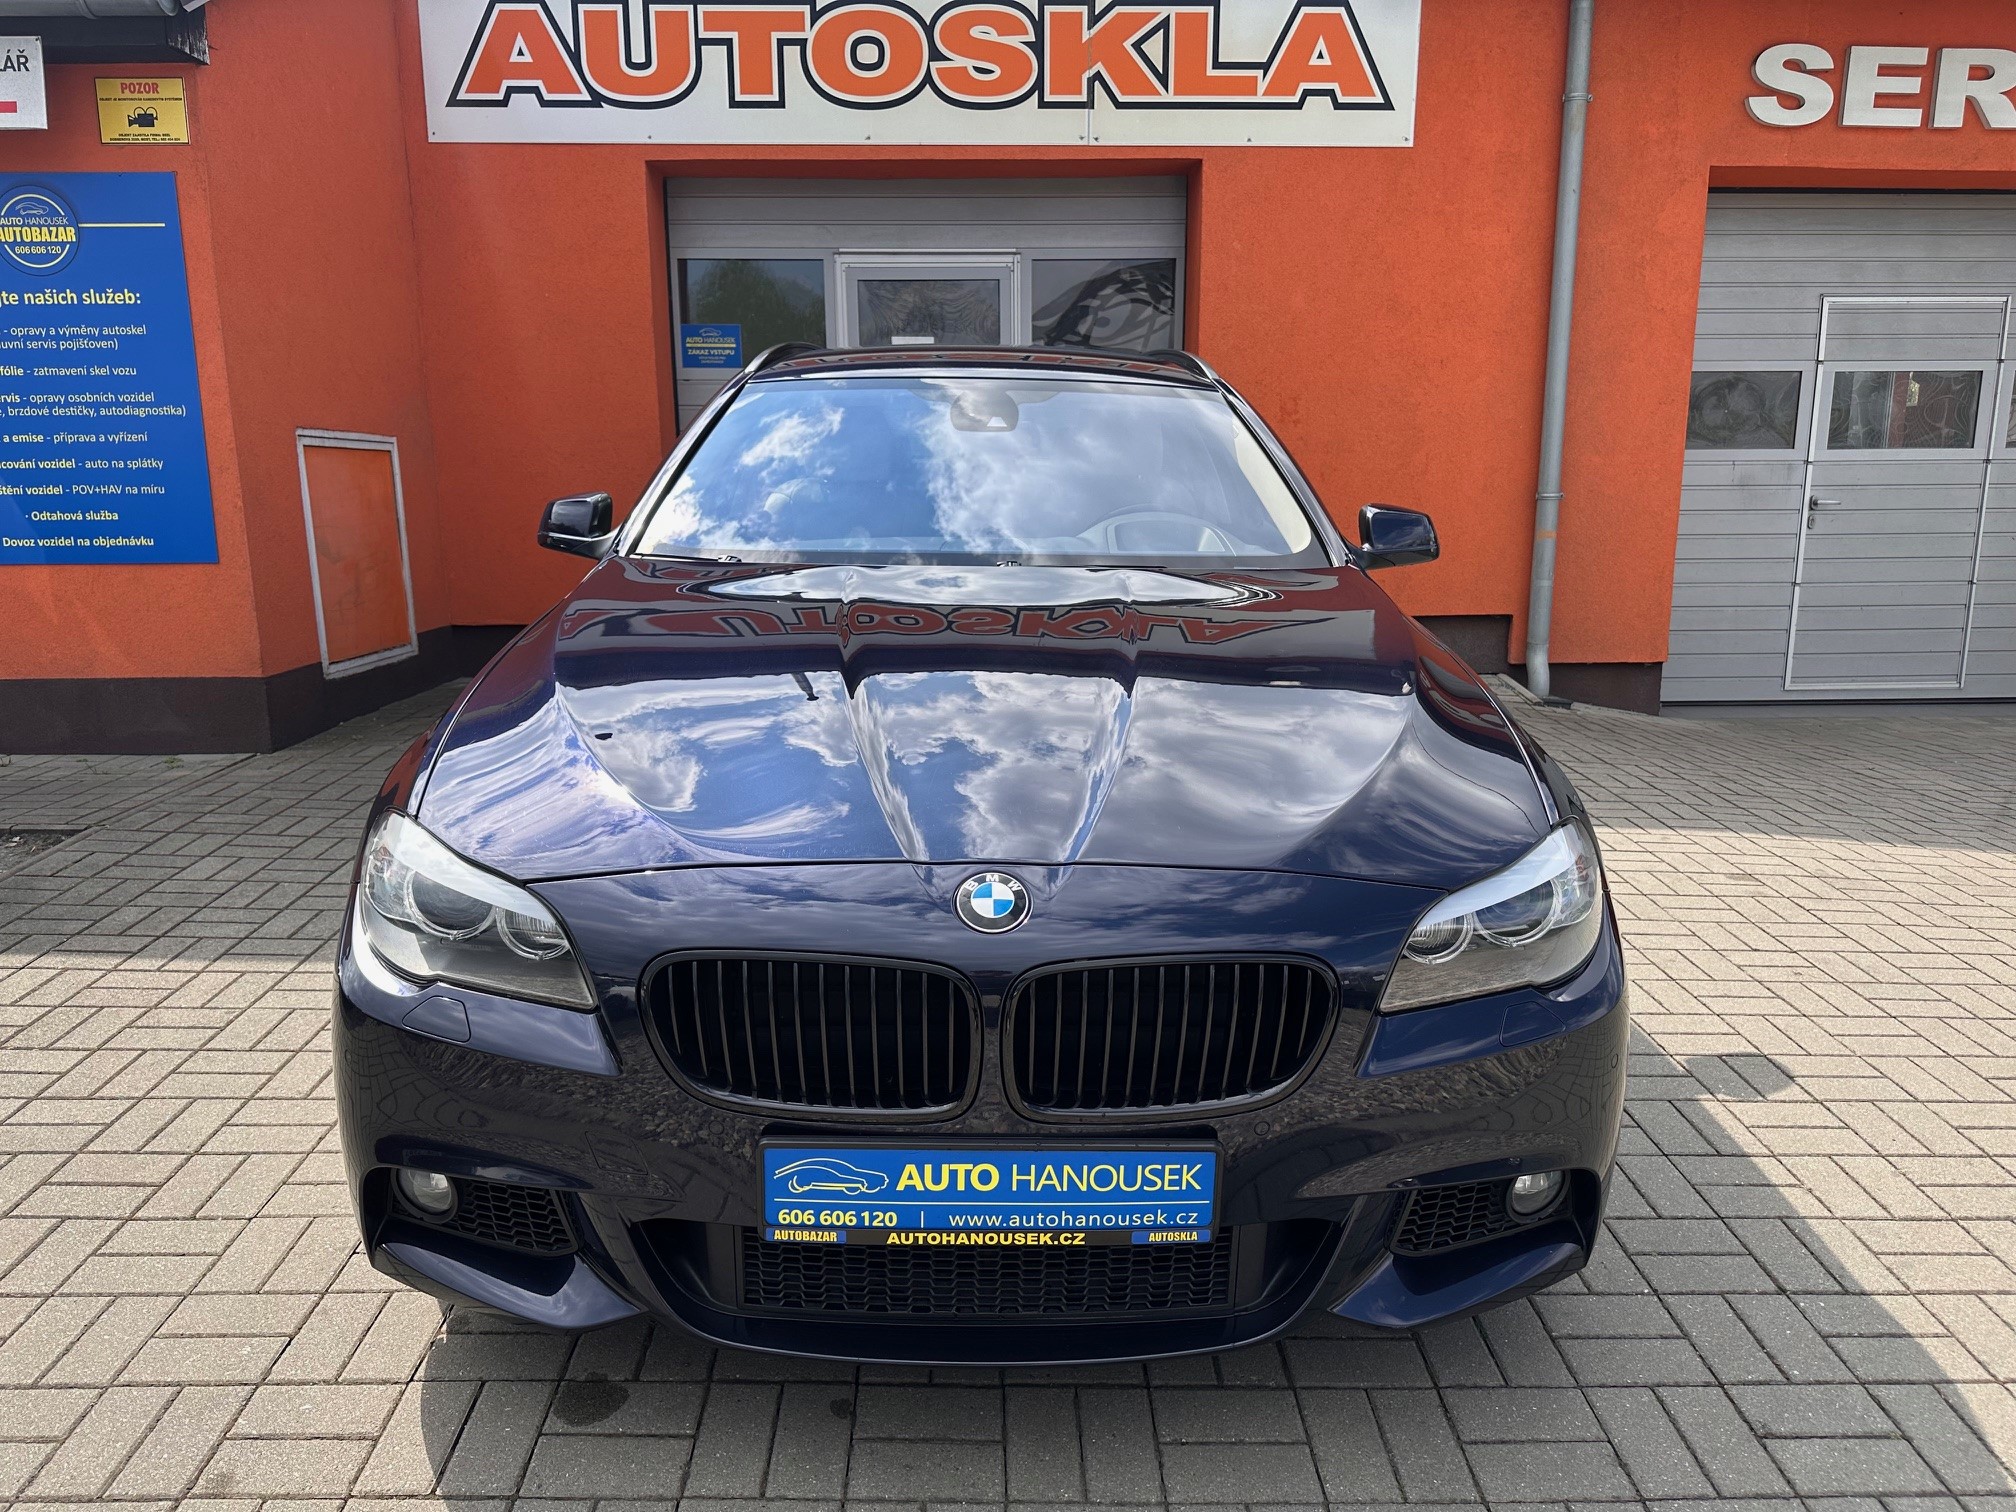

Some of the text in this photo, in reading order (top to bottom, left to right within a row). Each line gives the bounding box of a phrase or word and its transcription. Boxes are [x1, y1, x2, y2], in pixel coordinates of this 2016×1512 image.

[0, 49, 30, 72] ÁŘ
[447, 0, 1395, 110] AUTOSKLA
[120, 82, 160, 94] POZOR
[1, 217, 69, 225] AUTO HANOUSEK
[0, 227, 76, 242] AUTOBAZAR
[15, 246, 61, 254] 606 606 120
[24, 289, 77, 305] našich
[82, 289, 141, 305] služeb:
[10, 327, 46, 338] opravy
[49, 327, 55, 335] a
[58, 325, 99, 338] výměny
[102, 325, 146, 335] autoskel
[26, 338, 57, 349] servis
[60, 338, 118, 351] pojišťoven)
[0, 365, 24, 376] fólie
[33, 365, 87, 376] zatmavení
[89, 365, 110, 376] skel
[112, 367, 137, 376] vozu
[29, 395, 65, 405] opravy
[68, 392, 115, 403] osobních
[118, 392, 154, 402] vozidel
[8, 405, 50, 416] brzdové
[52, 405, 97, 418] destičky,
[100, 405, 186, 418] autodiagnostika)
[3, 434, 10, 443] a
[12, 432, 44, 443] emise
[53, 432, 96, 445] příprava
[98, 434, 105, 443] a
[107, 431, 148, 445] vyřízení
[37, 458, 76, 469] vozidel
[85, 460, 109, 469] auto
[111, 461, 125, 469] na
[127, 457, 164, 471] splátky
[25, 484, 63, 495] vozidel
[72, 484, 123, 495] POV+HAV
[125, 486, 138, 495] na
[140, 483, 165, 495] míru
[31, 510, 119, 521] Odtahová služba
[2, 535, 154, 548] Dovoz vozidel na objednávku
[964, 874, 1022, 892] BMW
[896, 1163, 1203, 1191] AUTO HANOUSEK
[778, 1209, 815, 1226] 606
[819, 1209, 857, 1227] 606
[860, 1210, 897, 1227] 120
[948, 1208, 1199, 1227] www.autohanousek.cz
[773, 1229, 1199, 1245] AUTOBAZAR AUTOHANOUSEK.CZ AUTOSKLA
